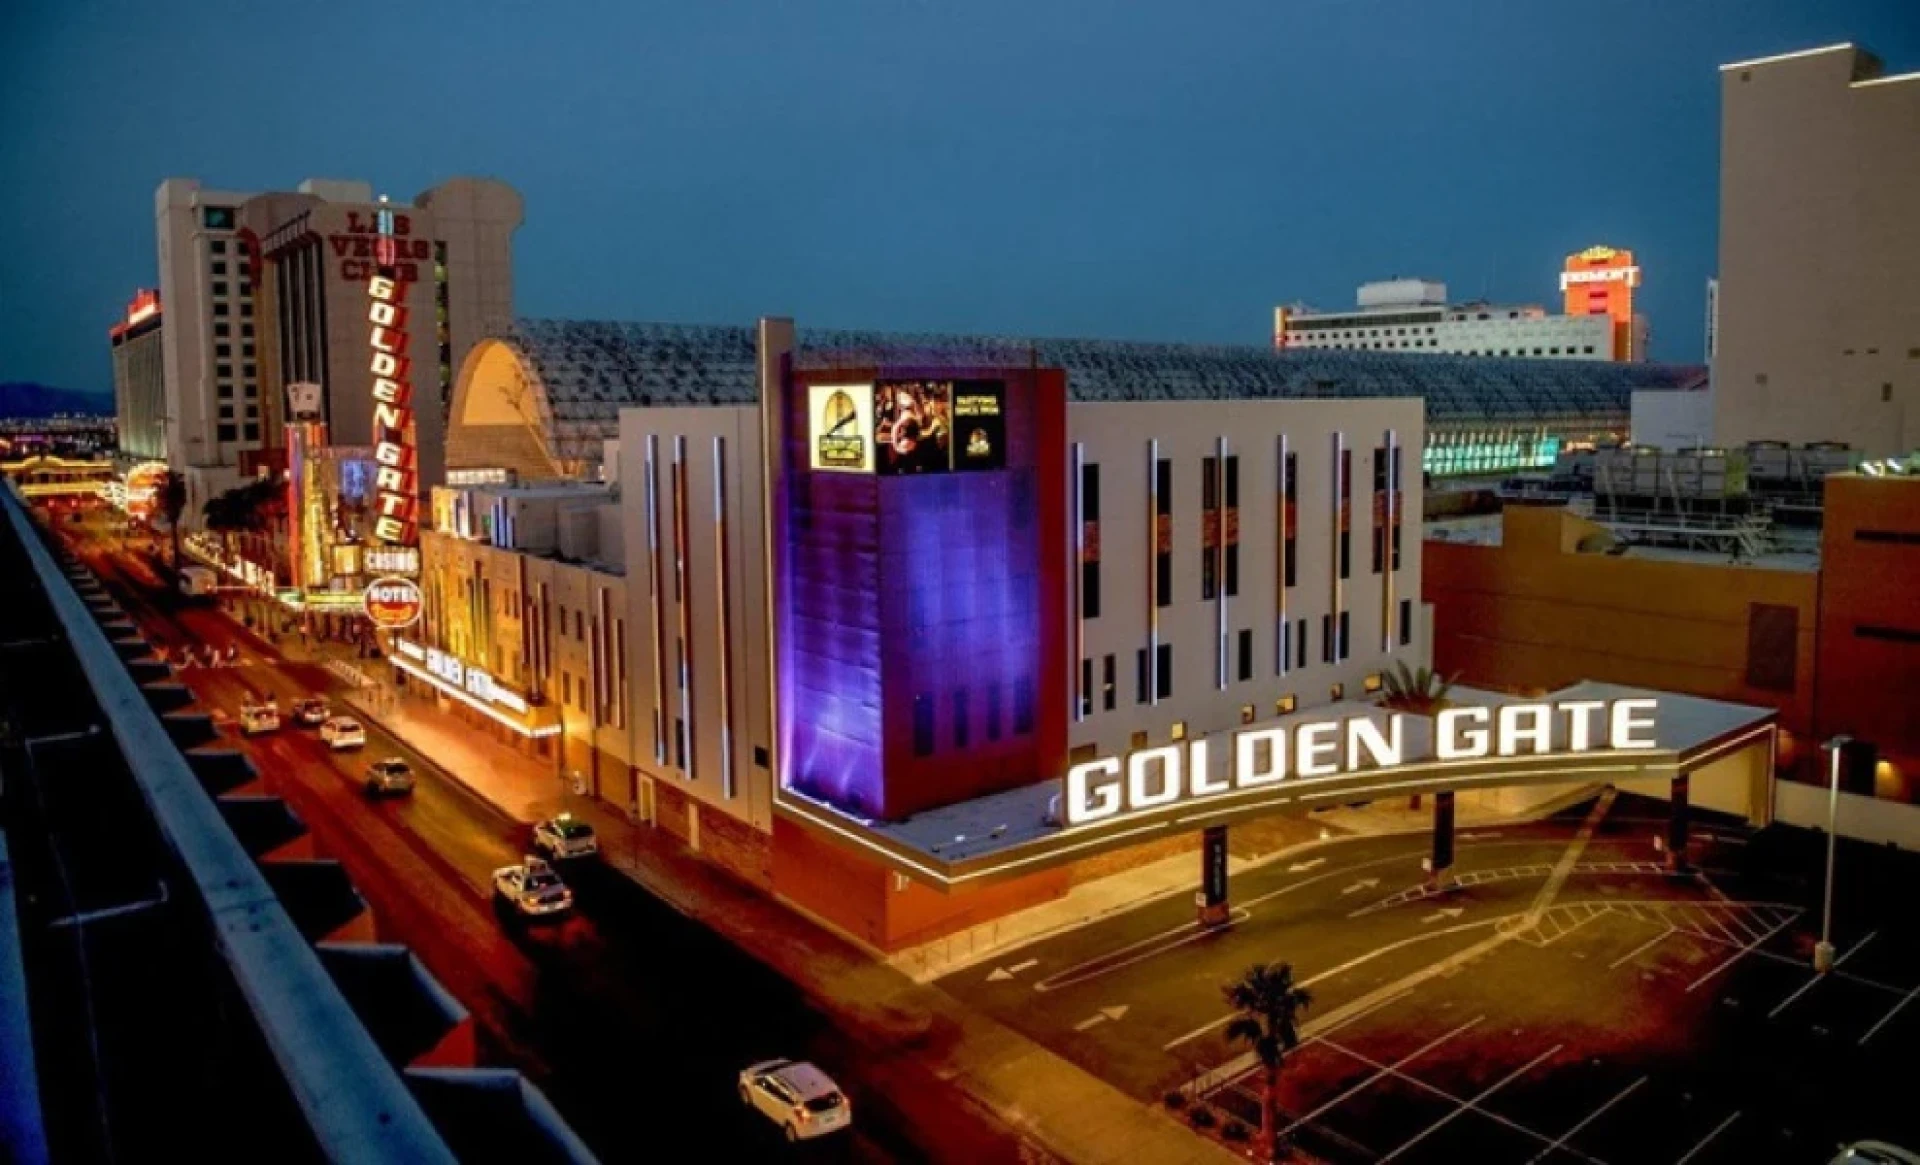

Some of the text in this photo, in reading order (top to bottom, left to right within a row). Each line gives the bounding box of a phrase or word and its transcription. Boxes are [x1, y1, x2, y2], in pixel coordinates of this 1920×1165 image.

[369, 275, 402, 541] GOLDEN GATE
[370, 586, 419, 602] HOTEL
[1067, 698, 1657, 823] GOLDEN GATE
